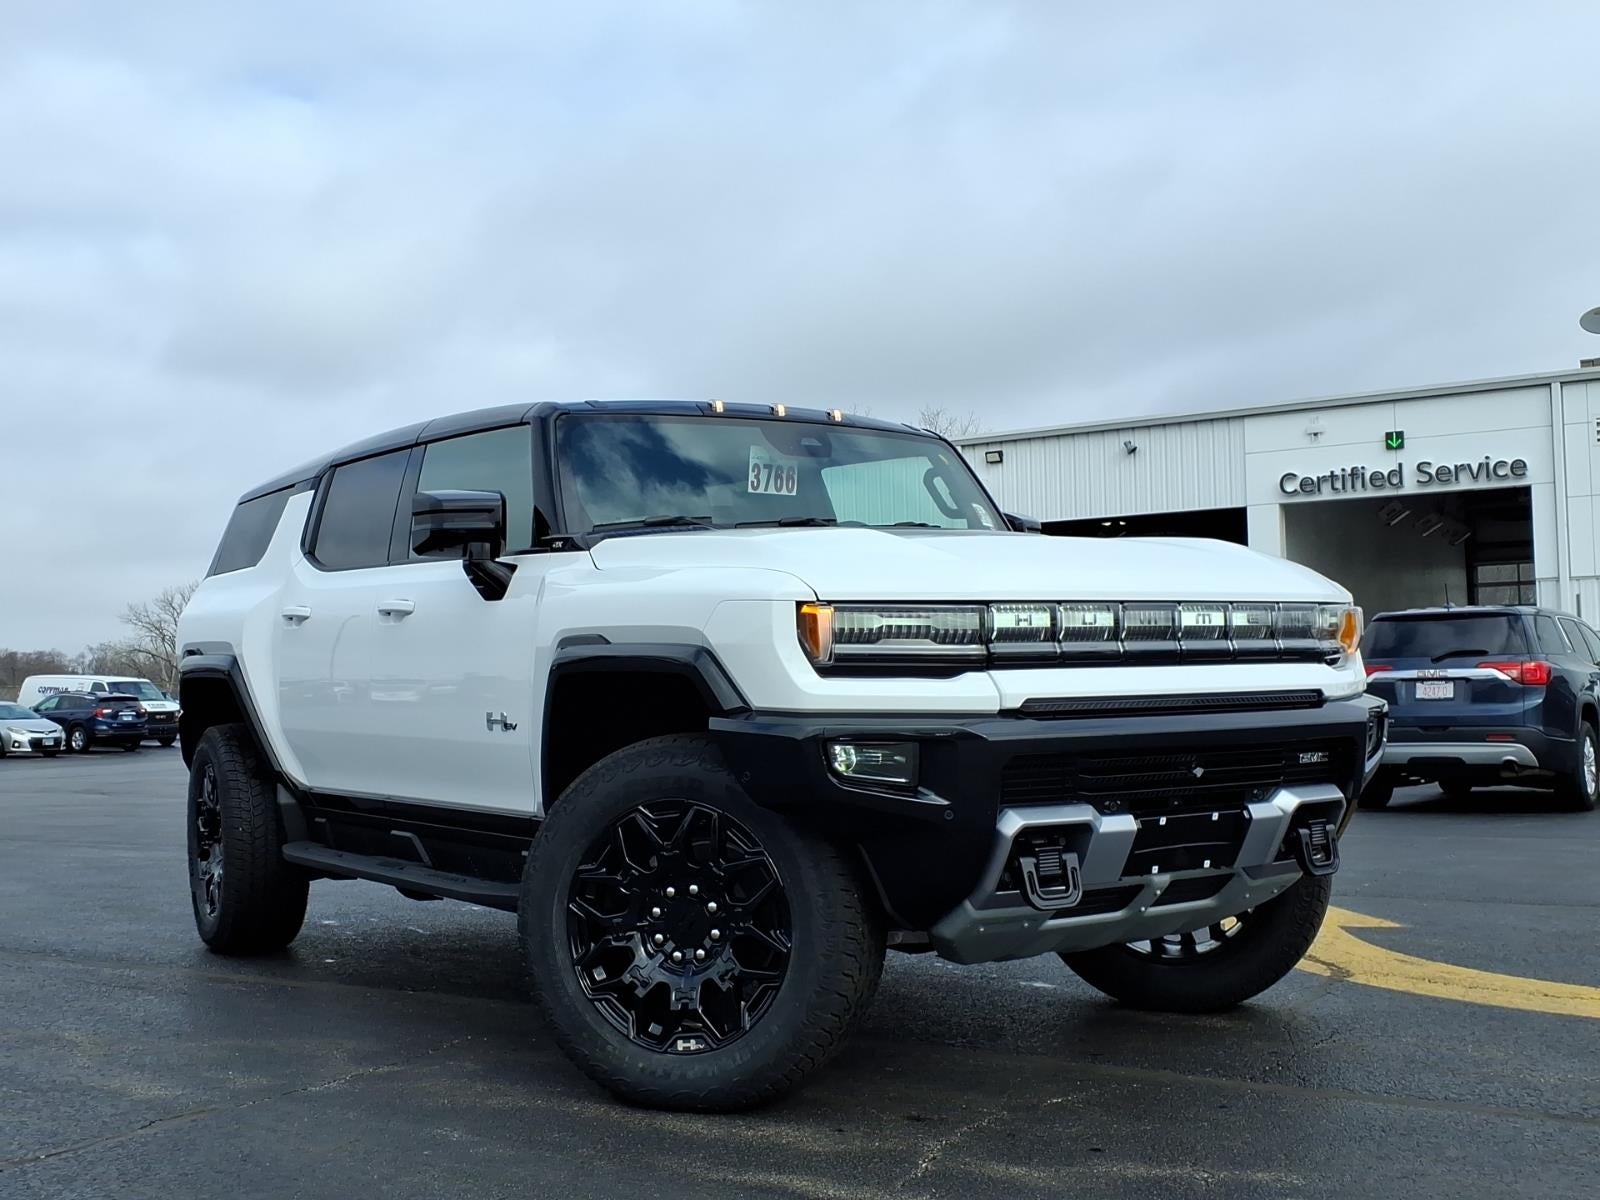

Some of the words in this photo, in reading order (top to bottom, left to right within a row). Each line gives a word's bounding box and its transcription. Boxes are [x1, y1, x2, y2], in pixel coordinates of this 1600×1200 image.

[750, 462, 796, 494] 3766
[1280, 462, 1403, 495] Certified
[1416, 455, 1528, 485] Service
